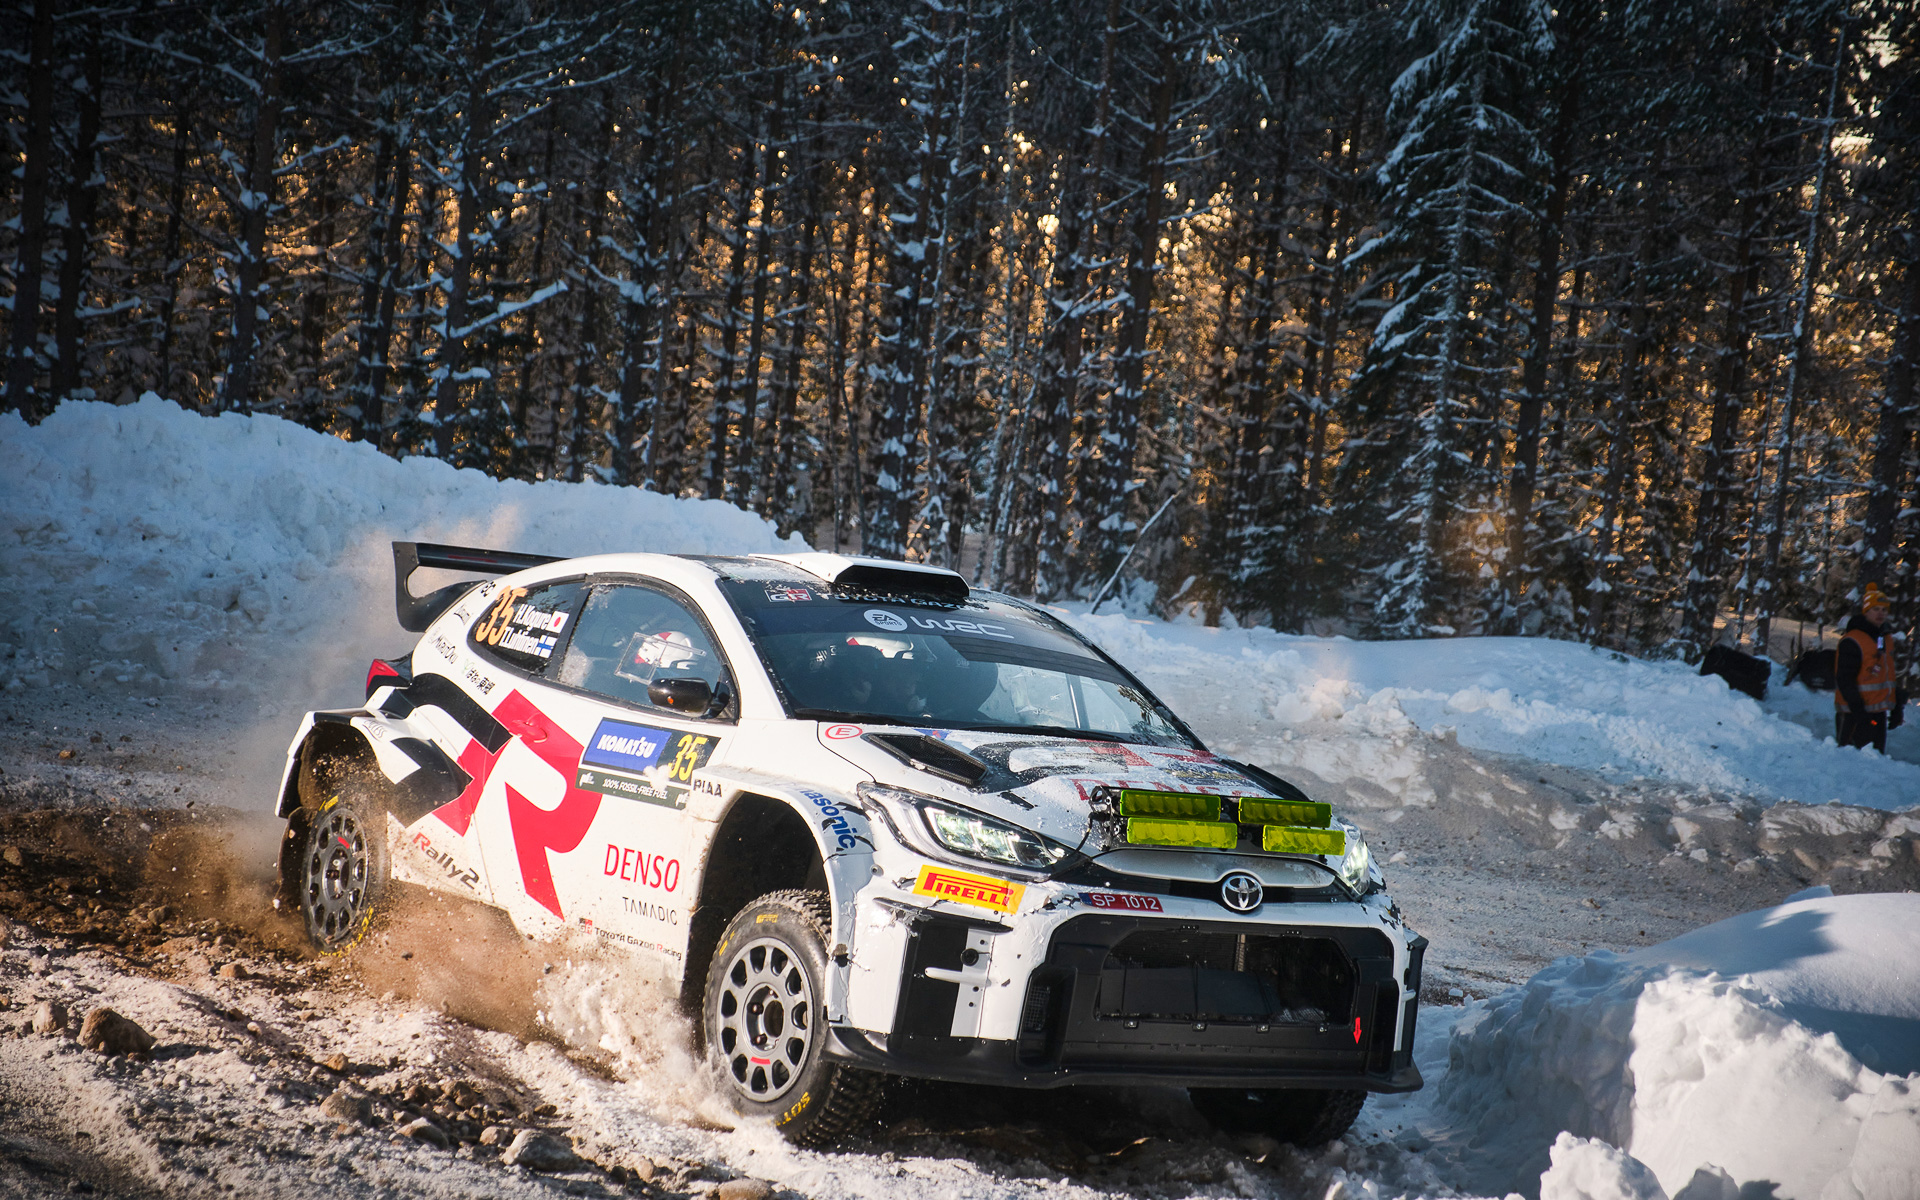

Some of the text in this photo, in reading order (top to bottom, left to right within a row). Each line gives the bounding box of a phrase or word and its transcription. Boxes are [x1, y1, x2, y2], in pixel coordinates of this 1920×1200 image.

[475, 585, 528, 646] 35
[910, 616, 1015, 639] WRC
[597, 733, 657, 759] KOMATSU
[668, 734, 708, 781] 35
[602, 778, 620, 791] 100%
[693, 779, 723, 798] PIAA
[412, 831, 480, 890] Rally2
[603, 843, 681, 893] DENSO
[923, 872, 1014, 907] PIRELLI
[1093, 894, 1161, 911] SP 1012
[622, 896, 678, 926] TAMADIC
[594, 926, 625, 943] TOYOTA
[656, 943, 682, 961] Racing
